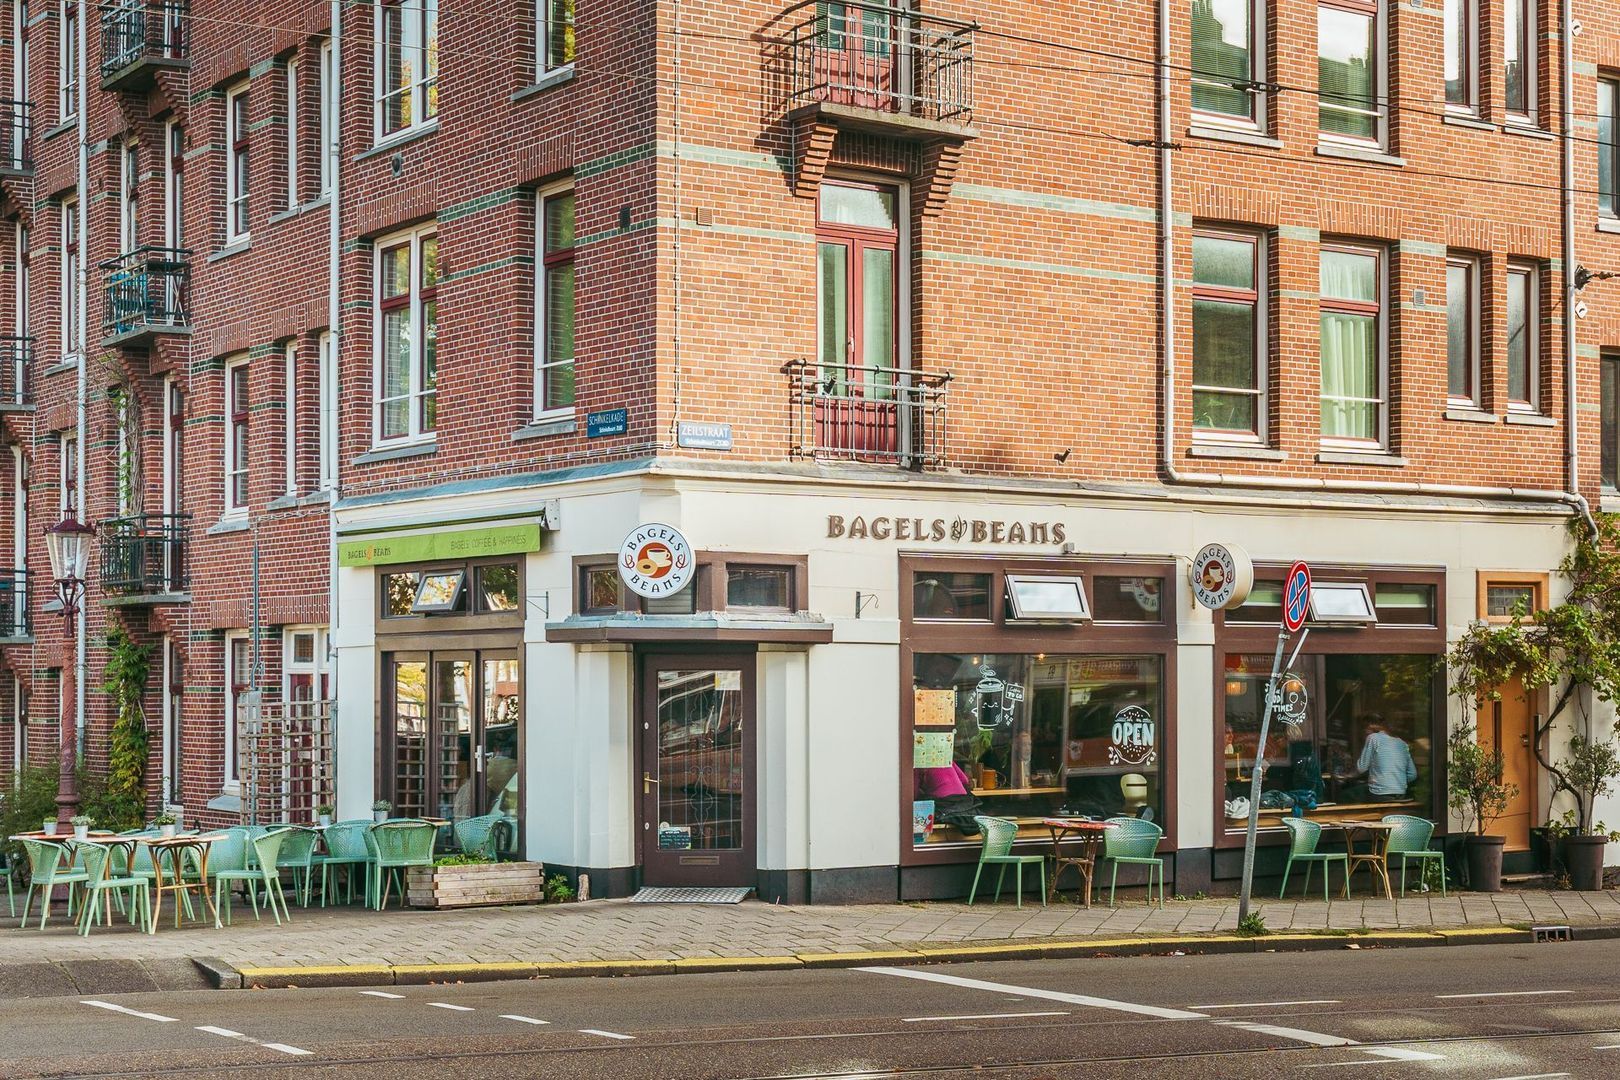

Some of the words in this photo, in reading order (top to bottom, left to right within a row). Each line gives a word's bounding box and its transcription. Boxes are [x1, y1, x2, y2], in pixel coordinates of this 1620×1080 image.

[682, 424, 729, 439] ZEILSTRAAT
[627, 528, 684, 551] BAGELS
[827, 514, 945, 541] BAGELS
[970, 519, 1067, 545] BEANS
[347, 549, 367, 560] BAGELS
[373, 547, 391, 557] BEANS
[1196, 547, 1231, 568] BAGELS
[630, 573, 681, 593] BEANS
[1198, 587, 1229, 605] BEANS
[1111, 722, 1155, 747] OPEN
